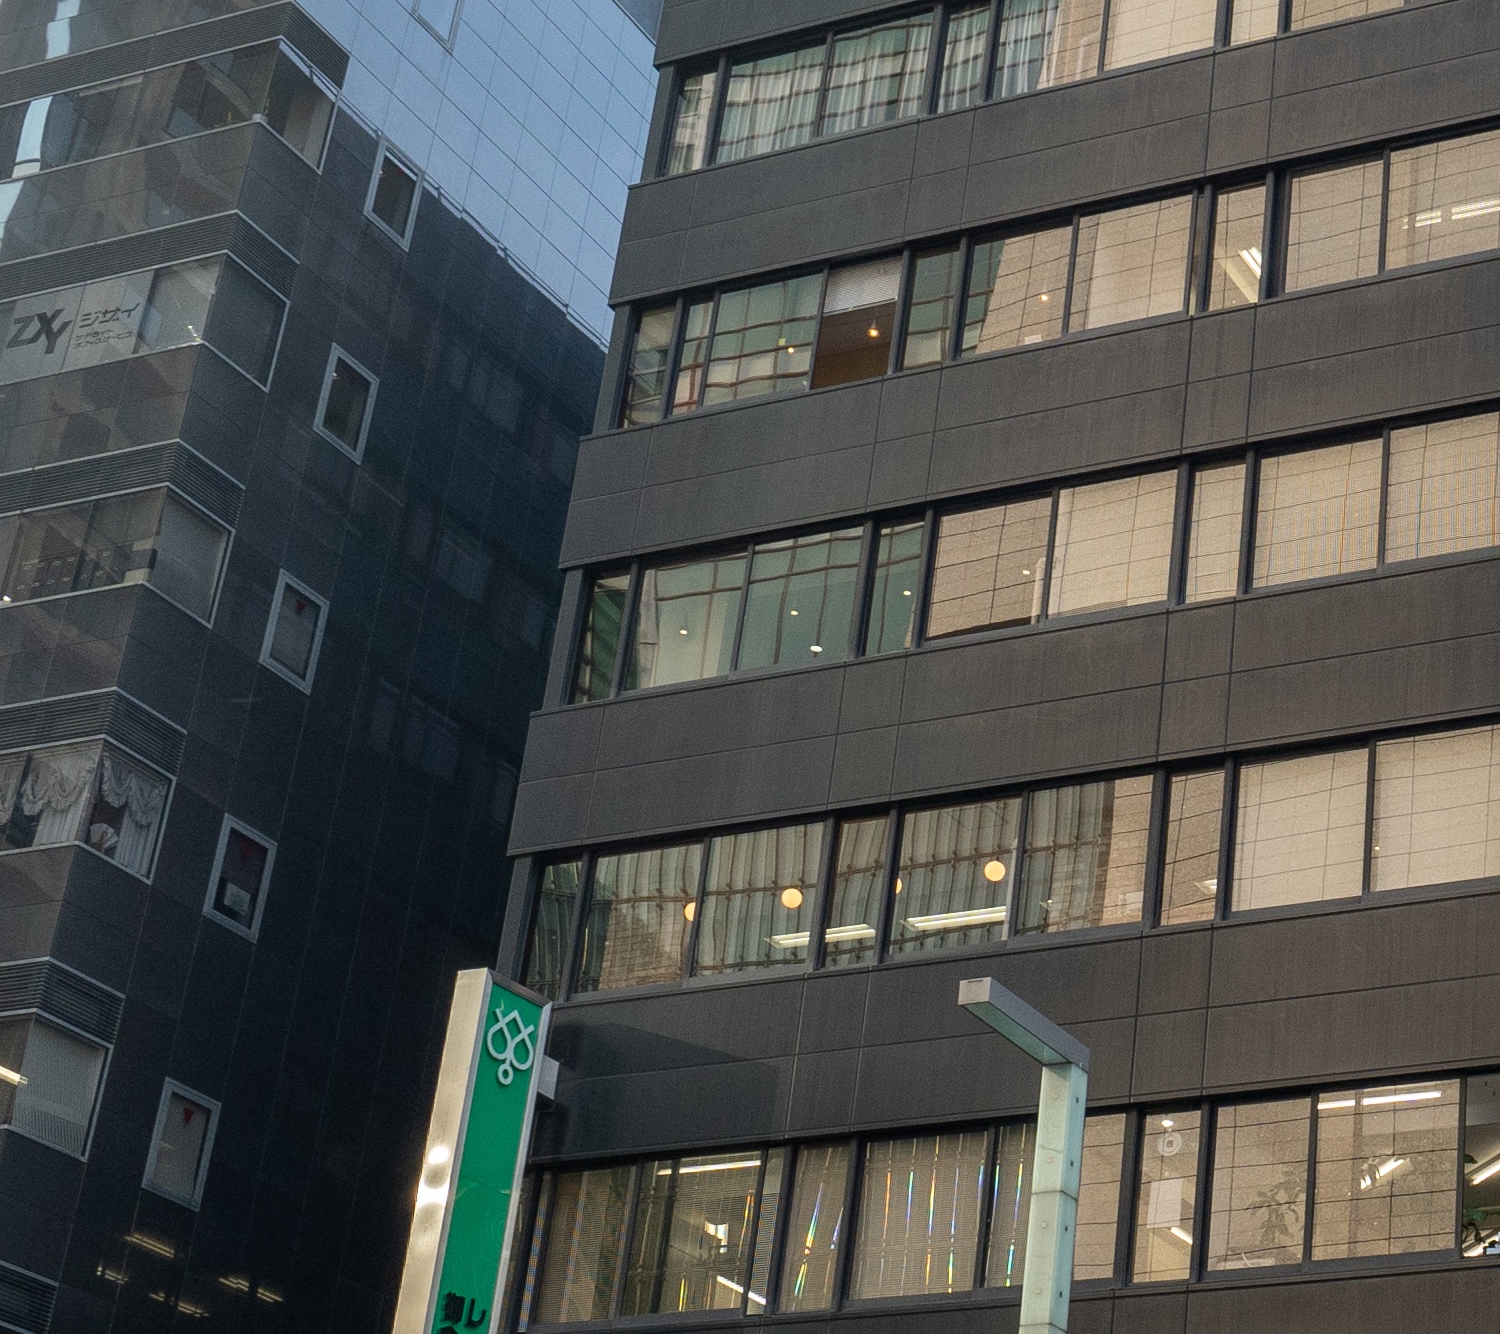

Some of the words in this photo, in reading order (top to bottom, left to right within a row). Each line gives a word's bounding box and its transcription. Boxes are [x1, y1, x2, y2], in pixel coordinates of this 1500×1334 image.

[6, 307, 73, 355] ZXY
[78, 303, 140, 329] ジザイ
